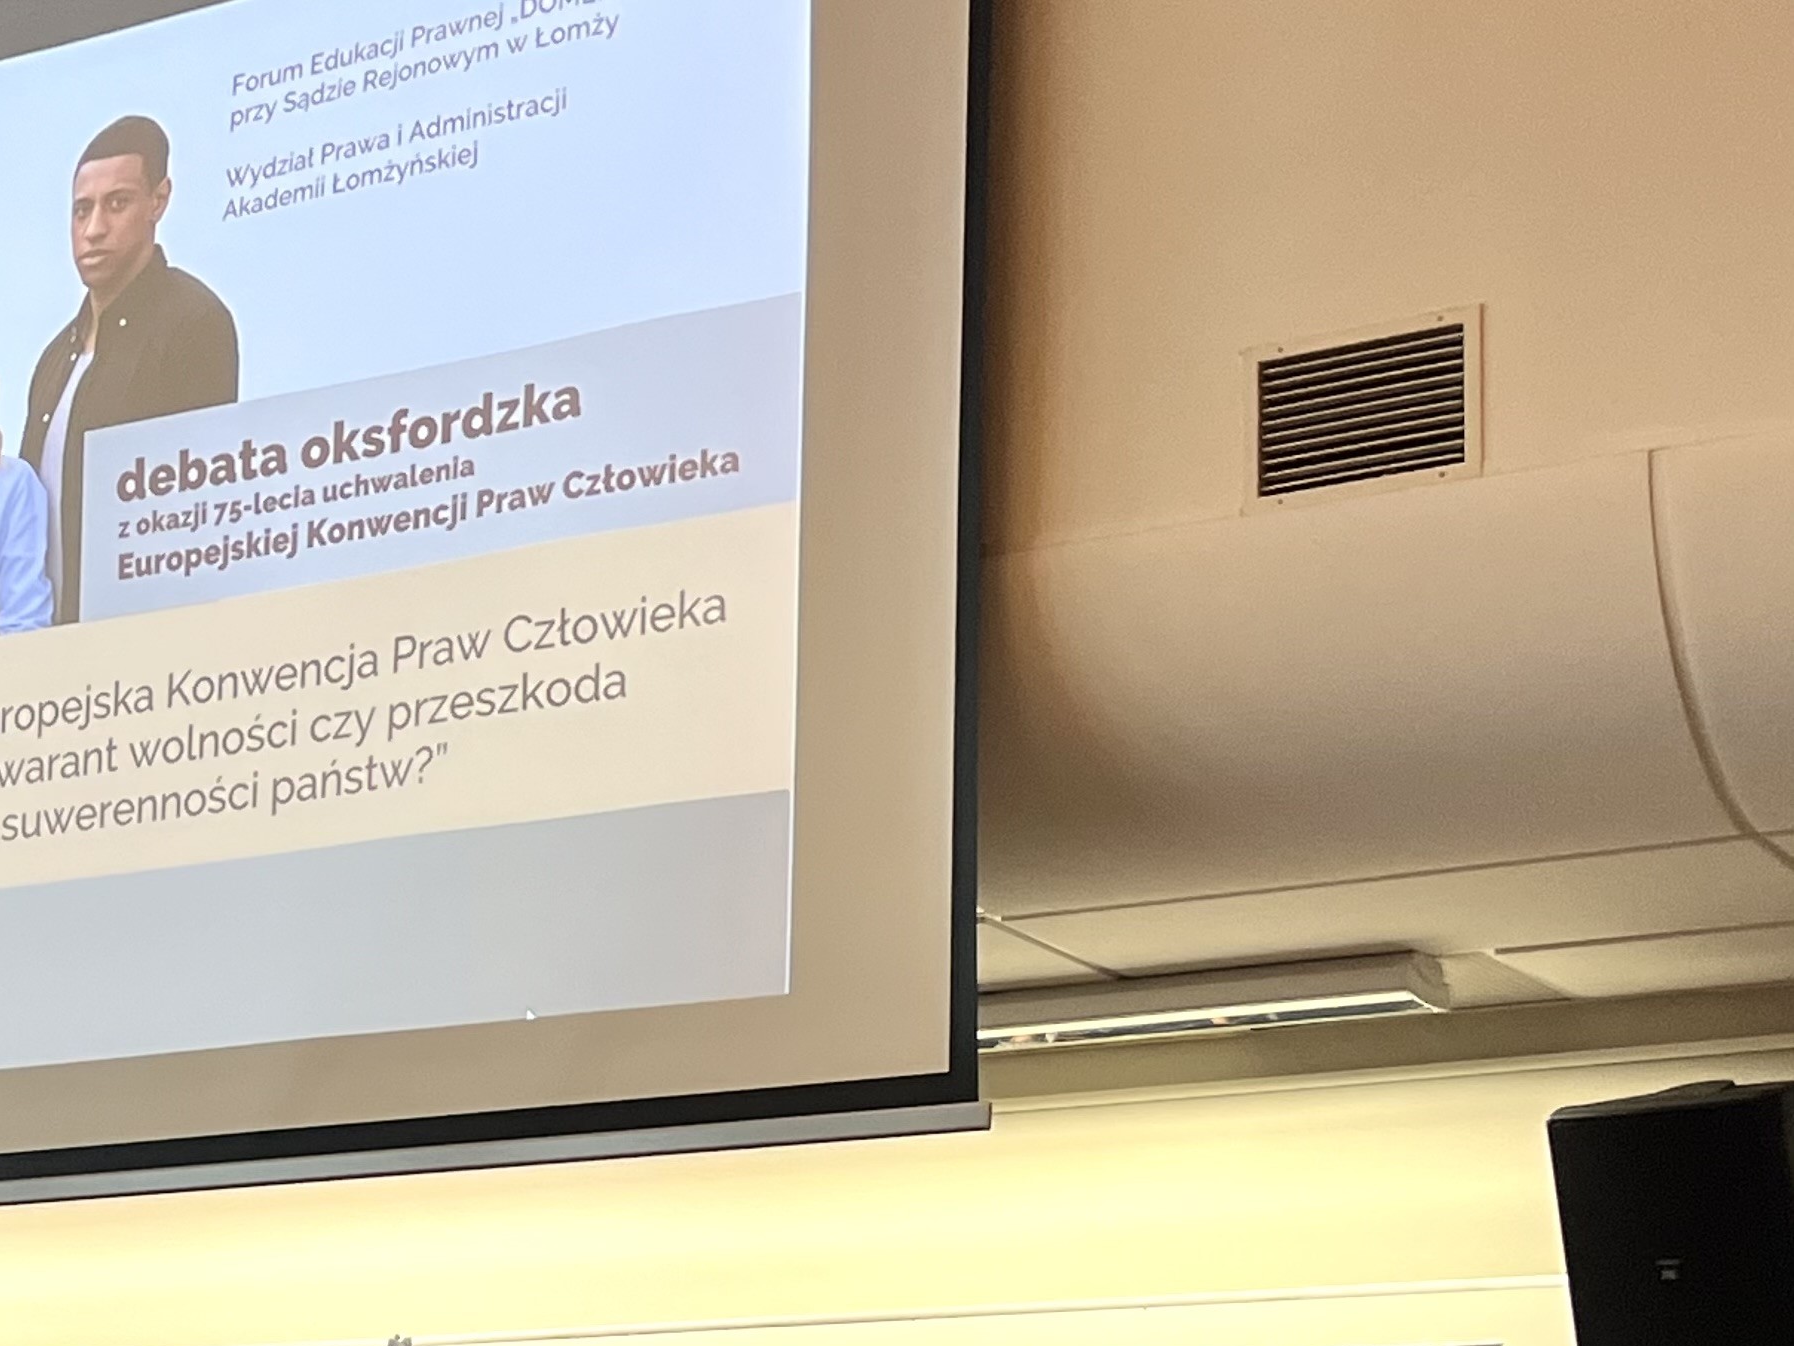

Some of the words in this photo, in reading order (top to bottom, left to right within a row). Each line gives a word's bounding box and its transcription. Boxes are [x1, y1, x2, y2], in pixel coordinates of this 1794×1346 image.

[229, 99, 277, 131] przy
[283, 81, 357, 112] Sądzie
[362, 41, 499, 91] Rejonowym
[506, 34, 528, 54] w
[535, 12, 619, 48] Łomży
[232, 62, 303, 96] Forum
[310, 31, 405, 76] Edukacji
[411, 2, 504, 49] Prawnej
[222, 175, 326, 221] Akademii
[332, 140, 479, 194] Łomżyńskiej
[226, 147, 314, 189] Wydział
[320, 132, 390, 165] Prawa
[397, 124, 404, 147] i
[409, 87, 568, 143] Administracji
[116, 439, 288, 502] debata
[301, 383, 582, 469] oksfordzka
[118, 521, 130, 538] z
[136, 502, 207, 536] okazji
[213, 484, 316, 527] 75-lecia
[323, 455, 475, 502] uchwalenia
[118, 523, 299, 580] Europejskiej
[306, 491, 468, 548] Konwencji
[476, 481, 556, 518] Praw
[563, 448, 740, 499] Człowieka
[167, 641, 379, 710] Konwencja
[392, 628, 492, 673] Praw
[503, 589, 727, 653] Człowieka
[129, 709, 298, 769] wolności
[310, 706, 376, 747] czy
[387, 663, 627, 740] przeszkoda
[1, 771, 259, 841] suwerenności
